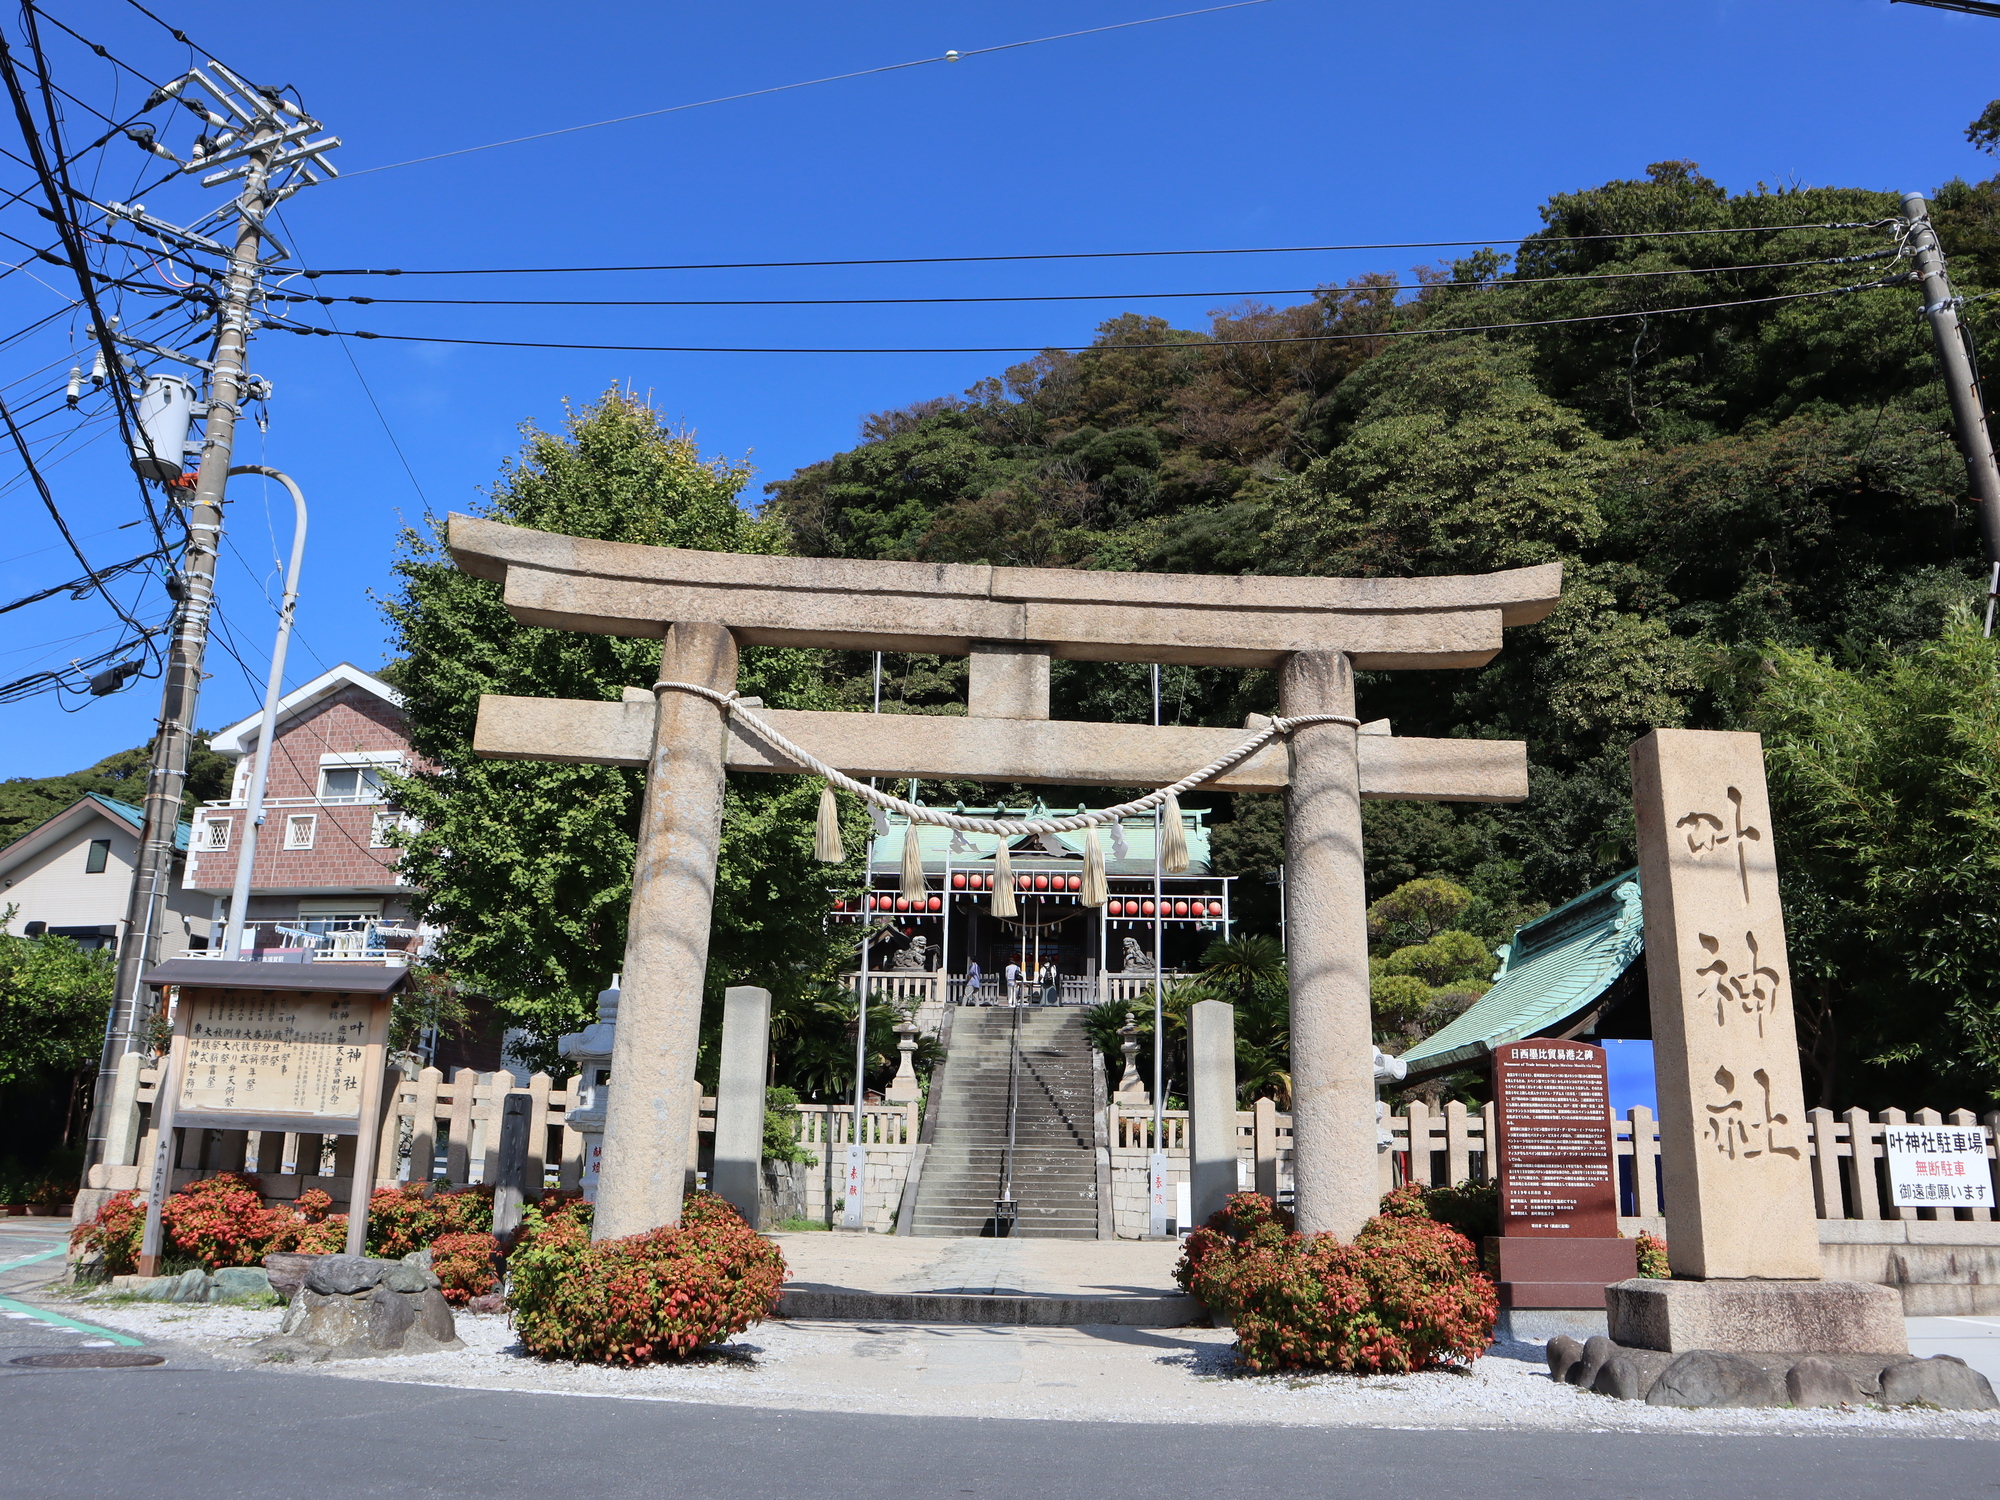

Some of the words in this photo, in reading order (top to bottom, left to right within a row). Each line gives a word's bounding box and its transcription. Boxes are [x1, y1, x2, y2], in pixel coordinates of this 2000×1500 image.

[1676, 785, 1801, 1161] 叶神社
[339, 1000, 350, 1020] 祭神
[220, 1028, 233, 1064] 例大祭
[280, 1015, 296, 1075] 叶神社祭事
[343, 1021, 364, 1091] 叶神社
[1511, 1048, 1594, 1061] 日西墨比貿易港之碑
[1889, 1131, 1984, 1155] 叶神社駐車場
[1915, 1160, 1966, 1177] 無断駐車
[1899, 1183, 1987, 1200] 御遠慮願います
